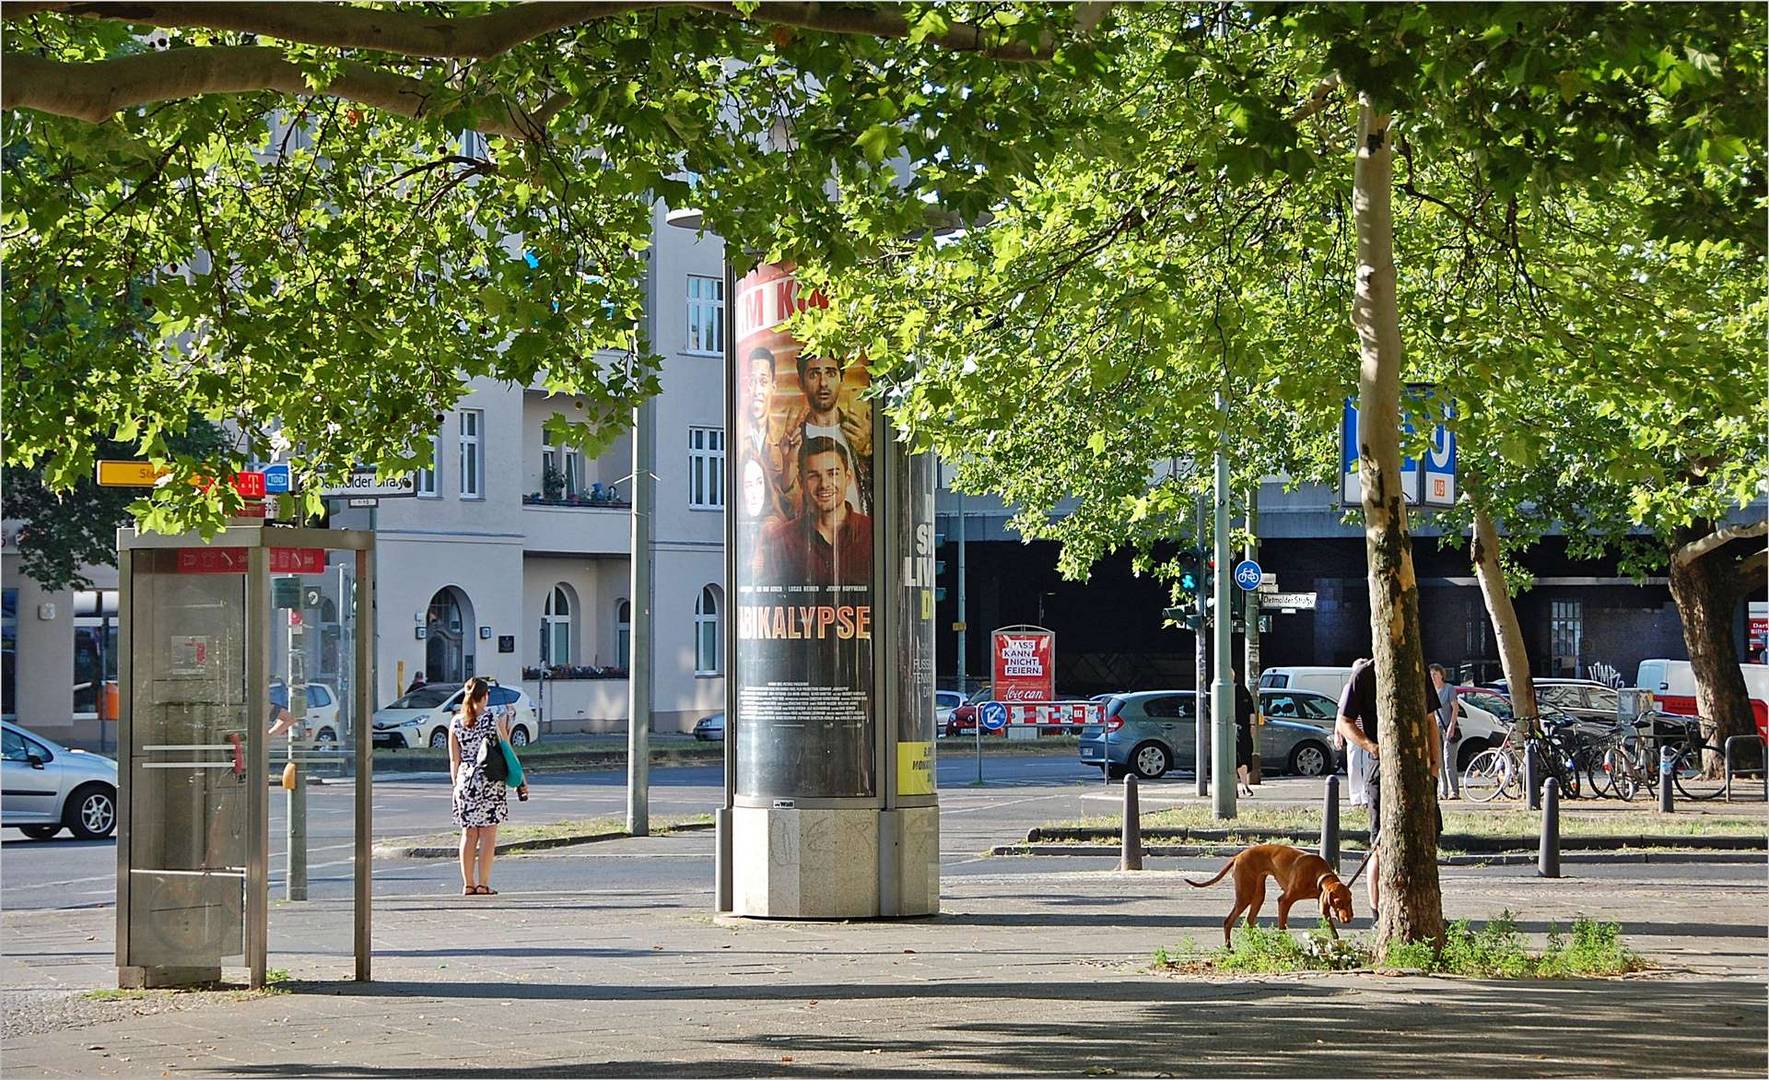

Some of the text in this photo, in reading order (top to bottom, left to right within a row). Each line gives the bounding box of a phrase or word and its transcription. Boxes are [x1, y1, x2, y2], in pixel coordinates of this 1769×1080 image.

[1430, 405, 1450, 468] U
[1009, 658, 1038, 666] NICHT
[1006, 666, 1041, 674] FEIERN.
